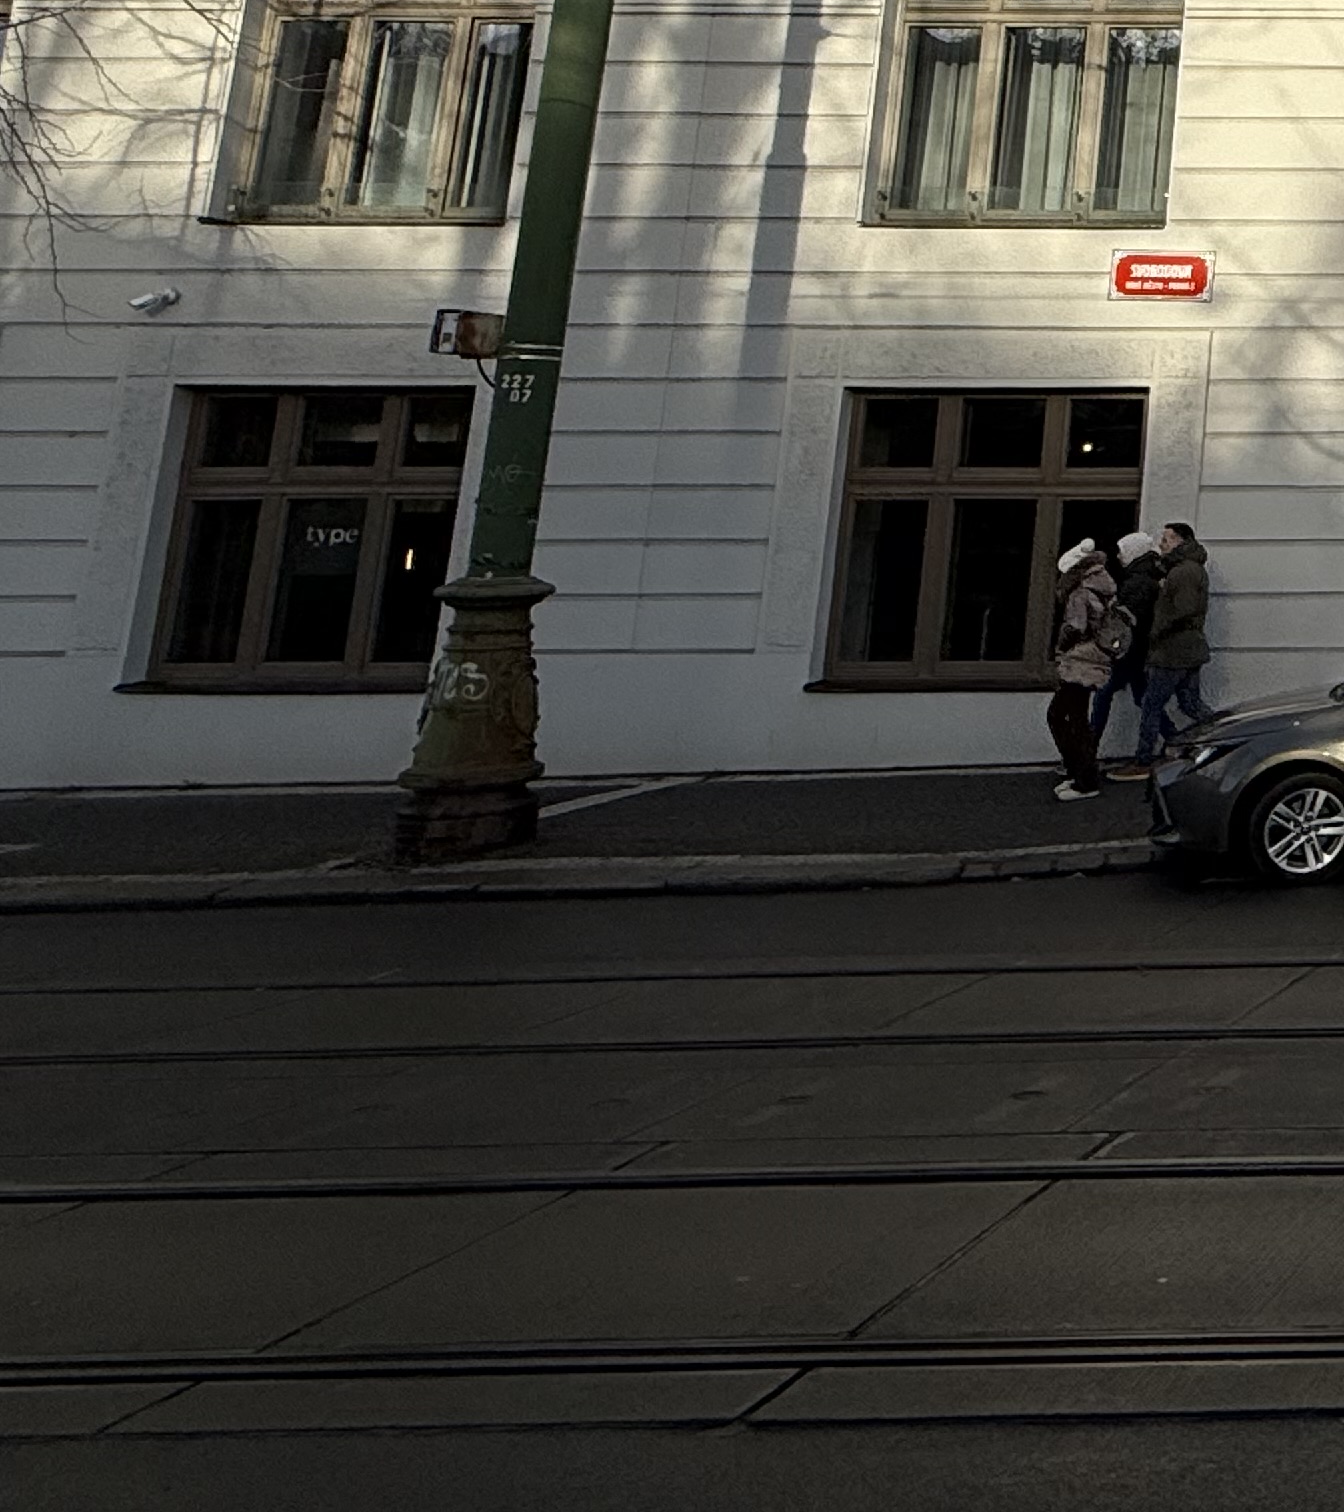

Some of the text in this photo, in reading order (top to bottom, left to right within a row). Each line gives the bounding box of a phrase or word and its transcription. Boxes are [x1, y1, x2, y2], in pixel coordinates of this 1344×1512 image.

[501, 374, 535, 389] 227
[509, 389, 532, 403] 07
[306, 525, 360, 548] type
